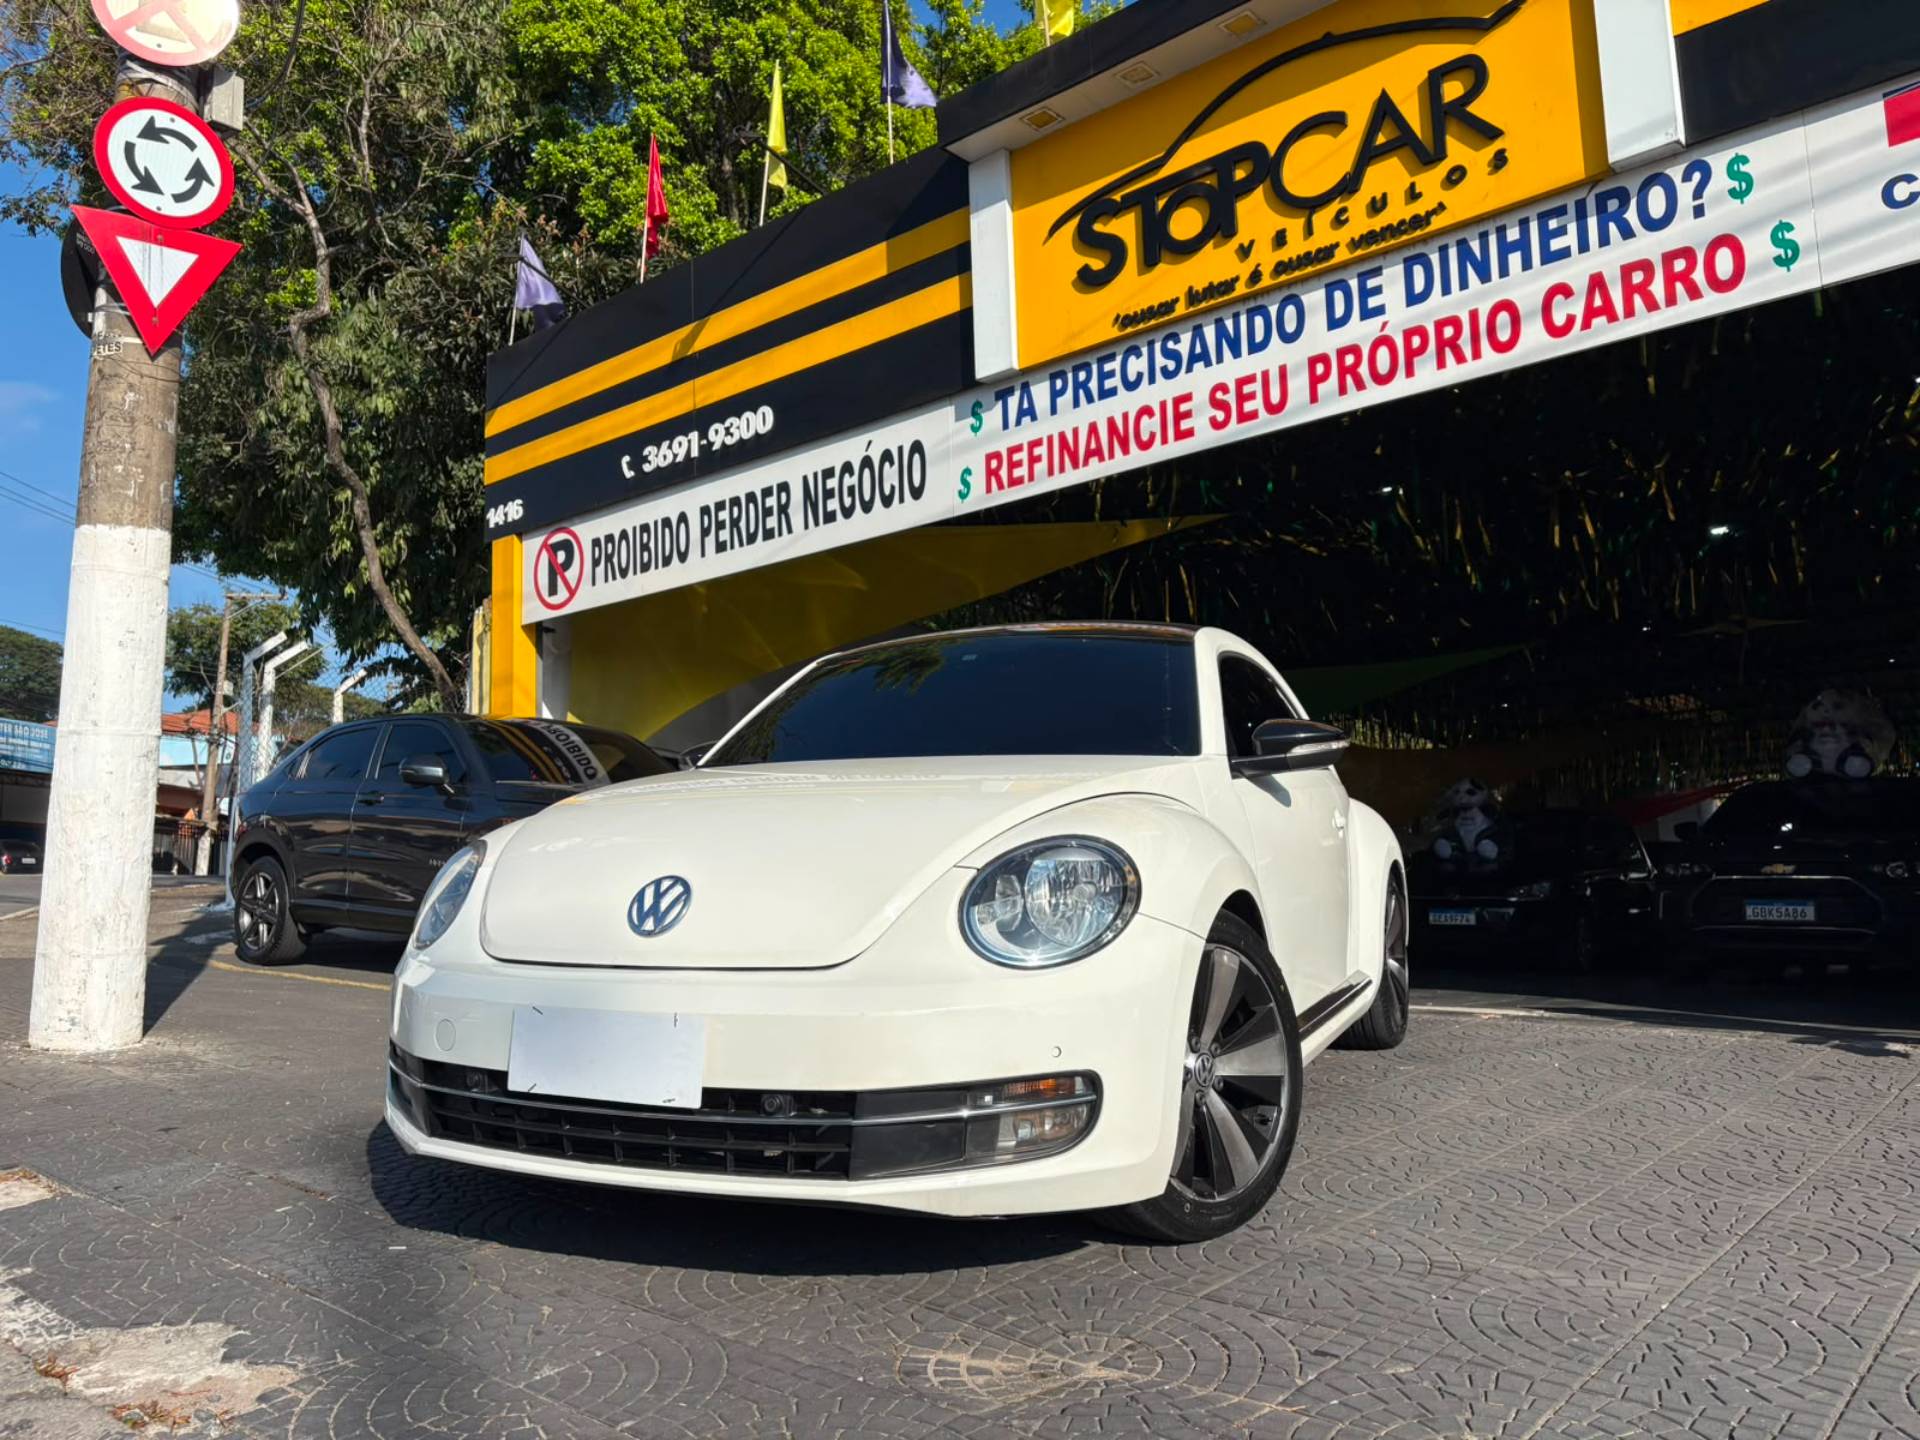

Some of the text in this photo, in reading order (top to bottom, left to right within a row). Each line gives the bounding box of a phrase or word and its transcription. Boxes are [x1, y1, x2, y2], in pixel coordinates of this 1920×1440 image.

[1076, 53, 1505, 287] STOPCAR
[995, 381, 1038, 432] TA
[1049, 293, 1306, 417] PRECISANDO
[1325, 265, 1386, 331] DE
[1404, 158, 1712, 308] DINHEIRO?
[1187, 275, 1240, 306] lutar
[1249, 263, 1263, 284] é
[1273, 241, 1340, 276] ousar
[985, 392, 1194, 495] REFINANCIE
[1208, 364, 1288, 432] SEU
[1308, 297, 1521, 404] PRÓPRIO
[1541, 232, 1746, 339] CARRO
[486, 499, 523, 528] 1416
[591, 510, 690, 587] PROIBIDO
[700, 480, 793, 558] PERDER
[802, 439, 926, 531] NEGÓCIO
[642, 405, 774, 474] 3691-9300
